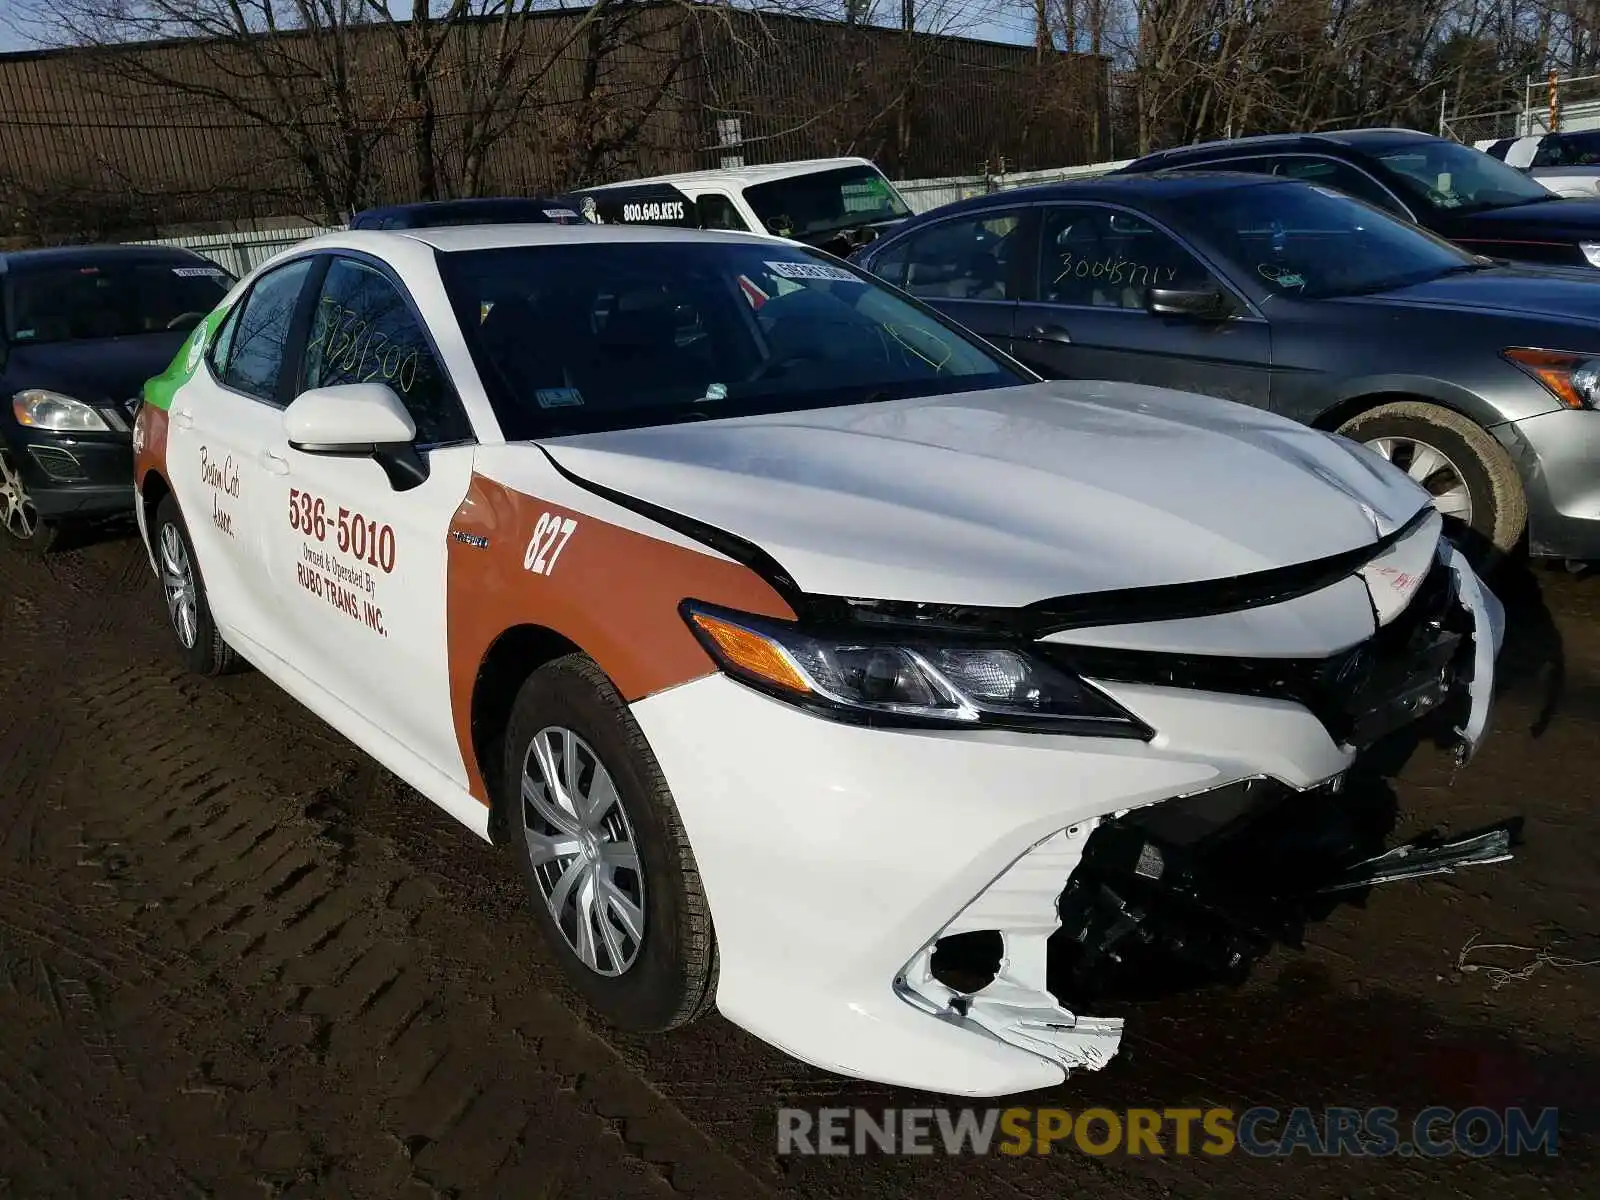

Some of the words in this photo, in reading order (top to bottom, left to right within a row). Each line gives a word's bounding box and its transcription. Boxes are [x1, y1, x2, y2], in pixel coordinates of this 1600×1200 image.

[623, 202, 684, 221] 800.649.KEYS
[224, 455, 240, 499] Cab
[289, 487, 396, 574] 536-5010
[524, 511, 578, 577] 827
[297, 562, 323, 598] RUBO
[324, 577, 362, 622] TRANS.
[363, 600, 388, 638] INC.
[303, 542, 325, 569] Owned
[325, 552, 331, 572] &
[332, 556, 364, 589] Operated
[365, 572, 376, 600] By
